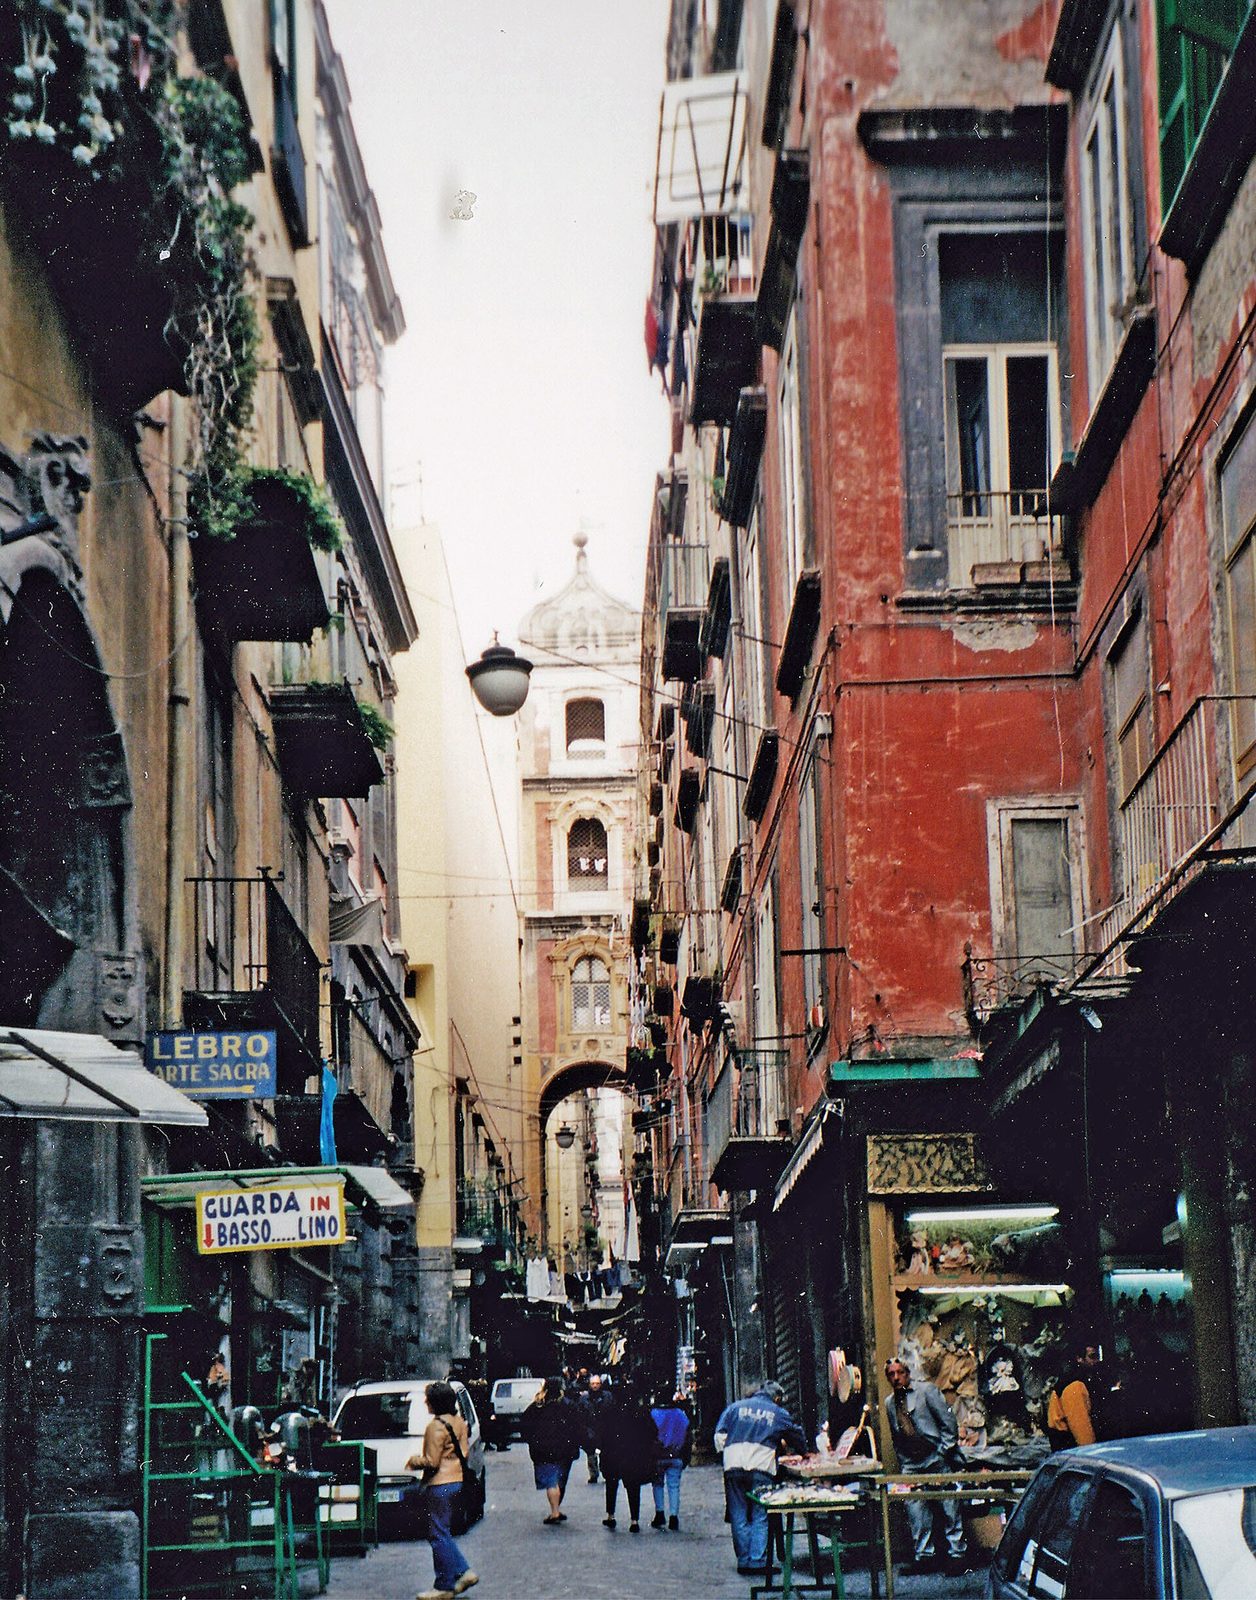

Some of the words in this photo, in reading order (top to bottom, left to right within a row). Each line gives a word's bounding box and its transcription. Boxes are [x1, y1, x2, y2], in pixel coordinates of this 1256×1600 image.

[152, 1034, 269, 1060] LEBRO
[154, 1064, 202, 1082] ARTE
[208, 1062, 271, 1081] SACRA
[204, 1191, 300, 1219] GUARDA
[310, 1195, 330, 1212] IN
